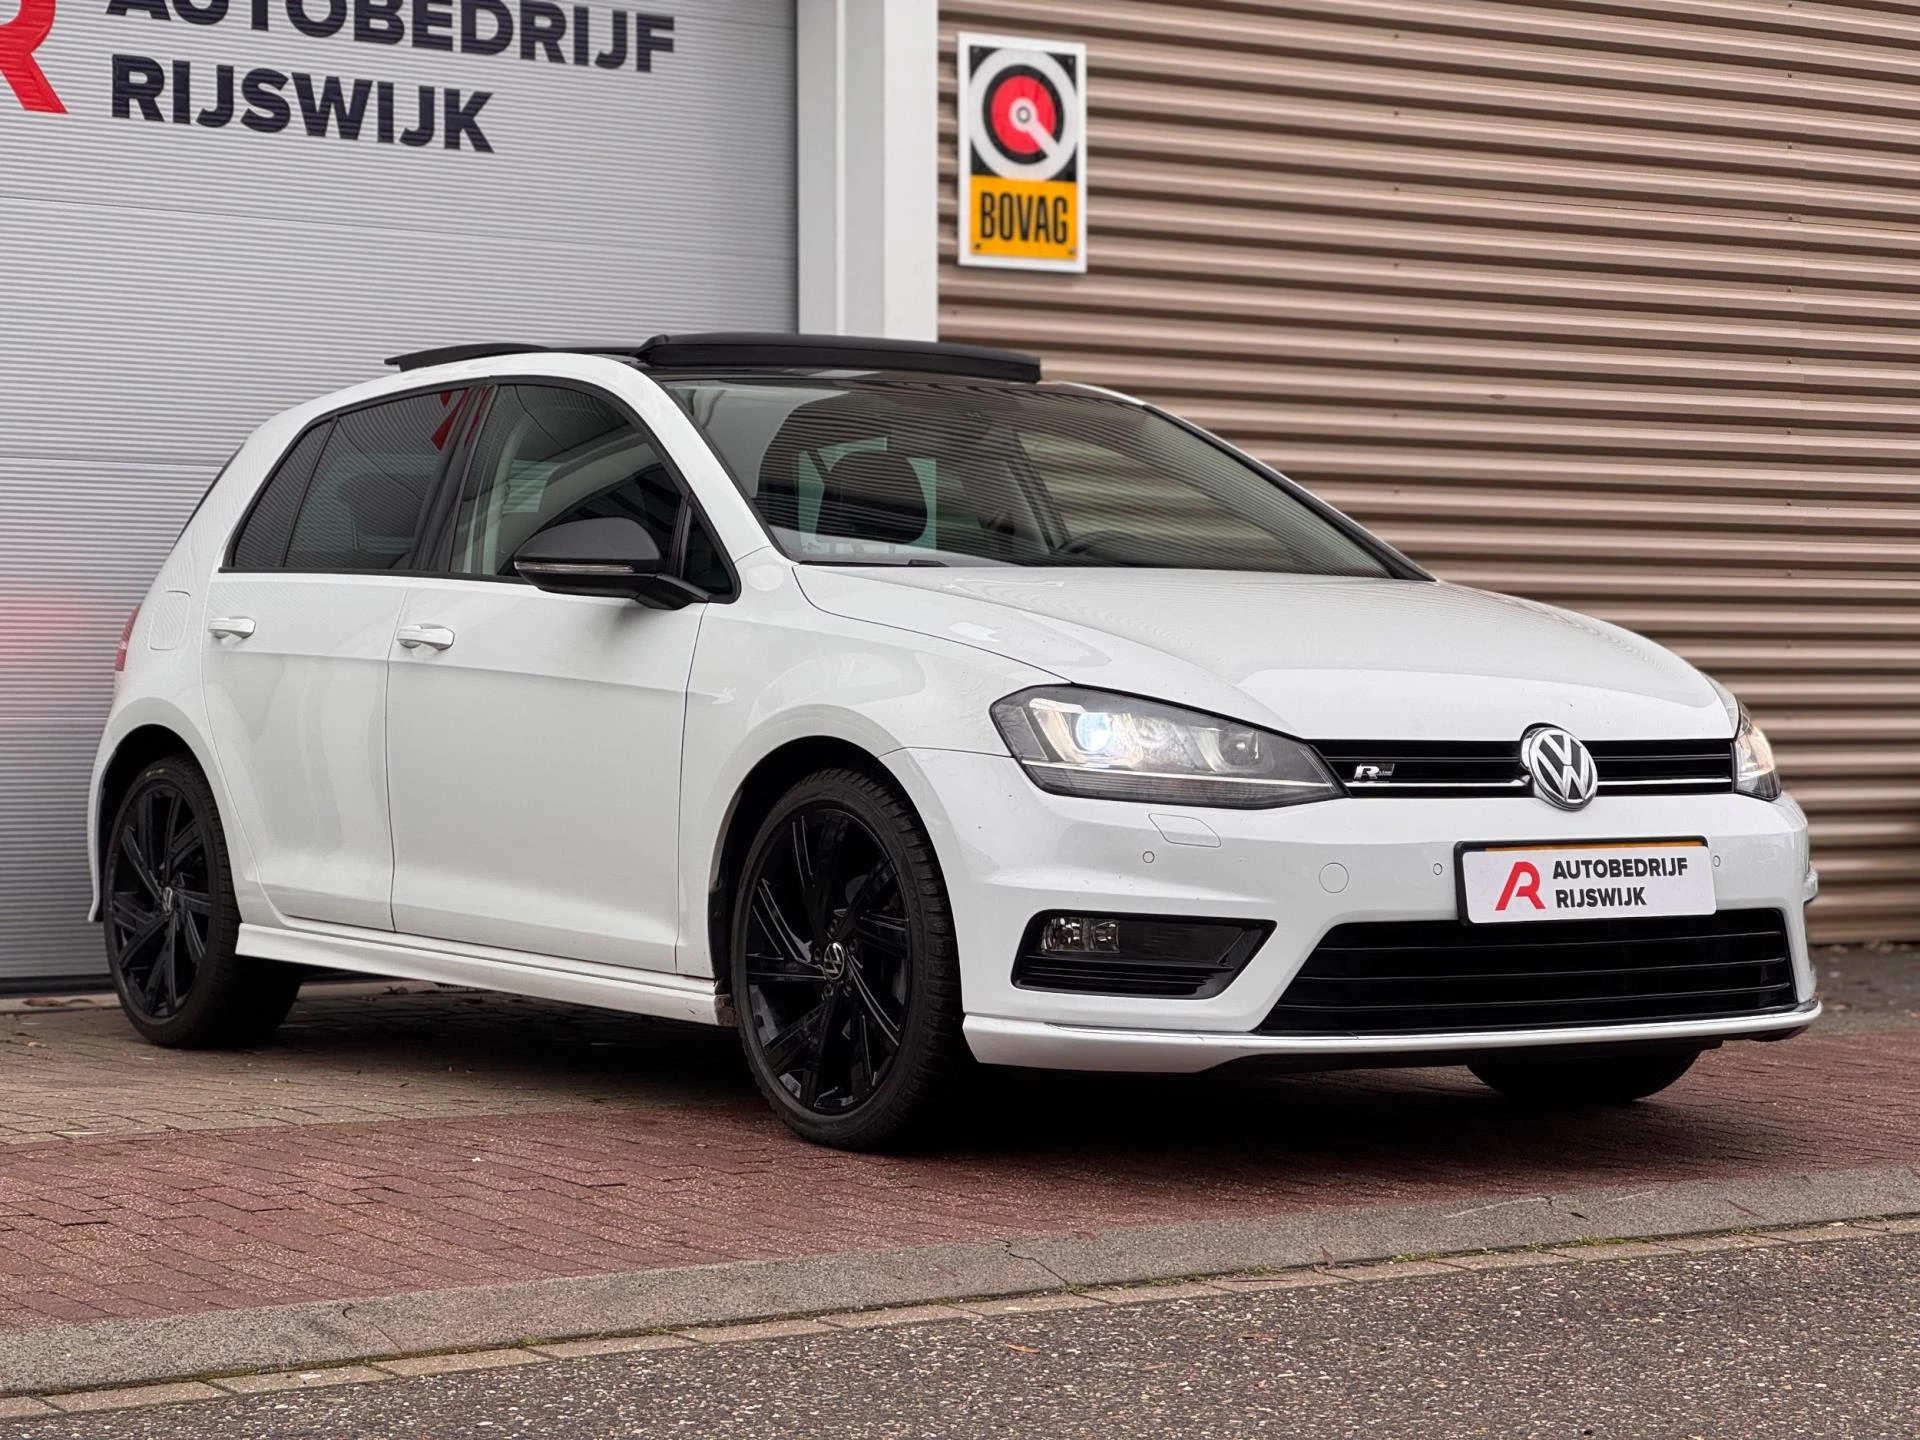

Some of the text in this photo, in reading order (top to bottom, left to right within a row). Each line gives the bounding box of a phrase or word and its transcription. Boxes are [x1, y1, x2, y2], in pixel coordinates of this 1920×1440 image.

[111, 53, 495, 153] RIJSWIJK
[980, 191, 1068, 244] BOVAG
[1553, 857, 1688, 880] AUTOBEDRIJF
[1555, 886, 1647, 909] RIJSWIJK
